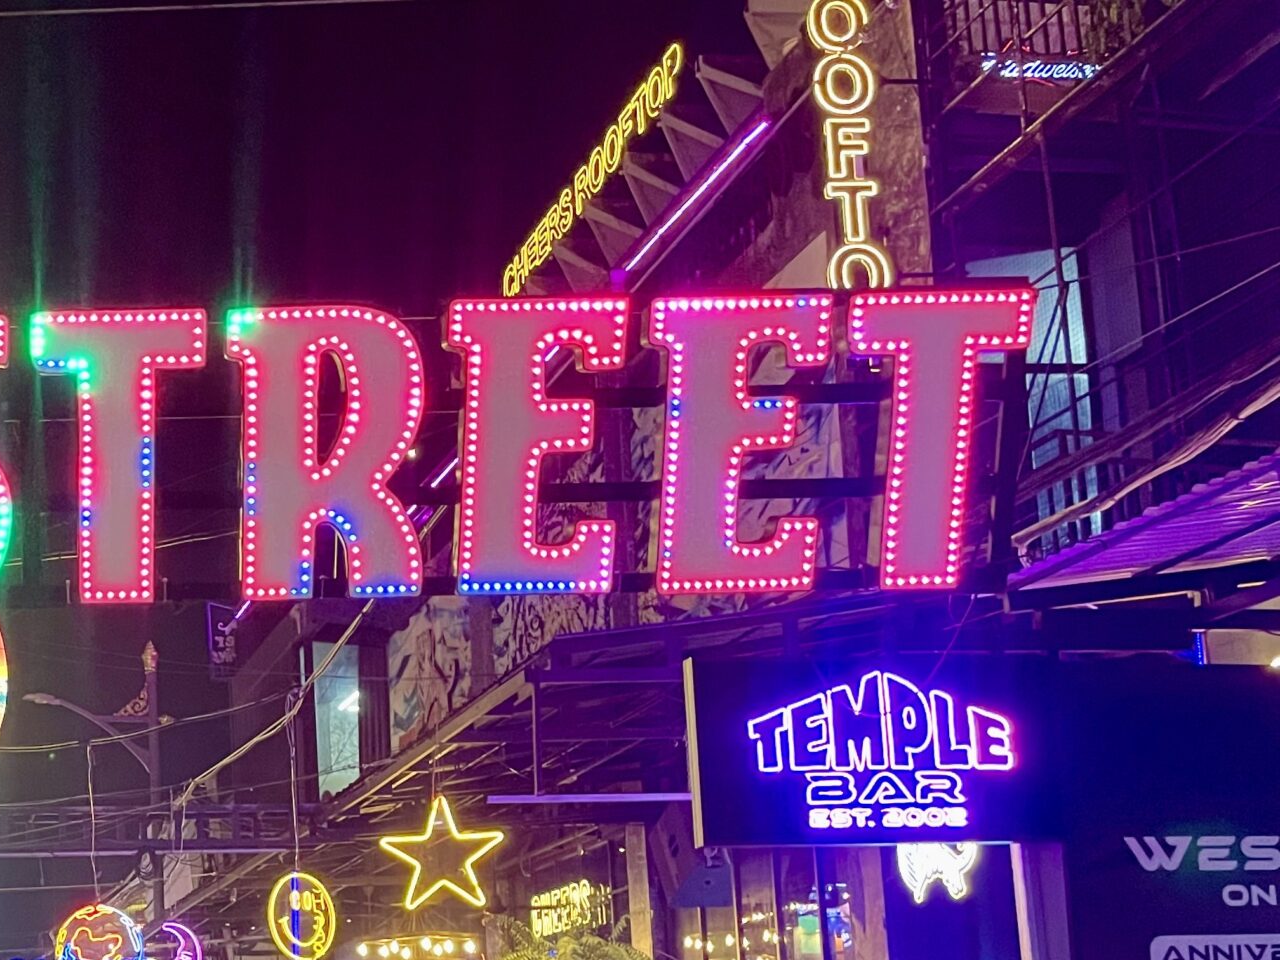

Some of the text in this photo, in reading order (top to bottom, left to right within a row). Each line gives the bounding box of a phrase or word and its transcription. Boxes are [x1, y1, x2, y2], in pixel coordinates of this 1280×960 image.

[503, 43, 682, 297] CHEERS ROOFTOP
[748, 671, 1015, 772] TEMPLE
[805, 770, 968, 806] BAR
[808, 808, 876, 828] EST.
[1222, 884, 1277, 907] ON
